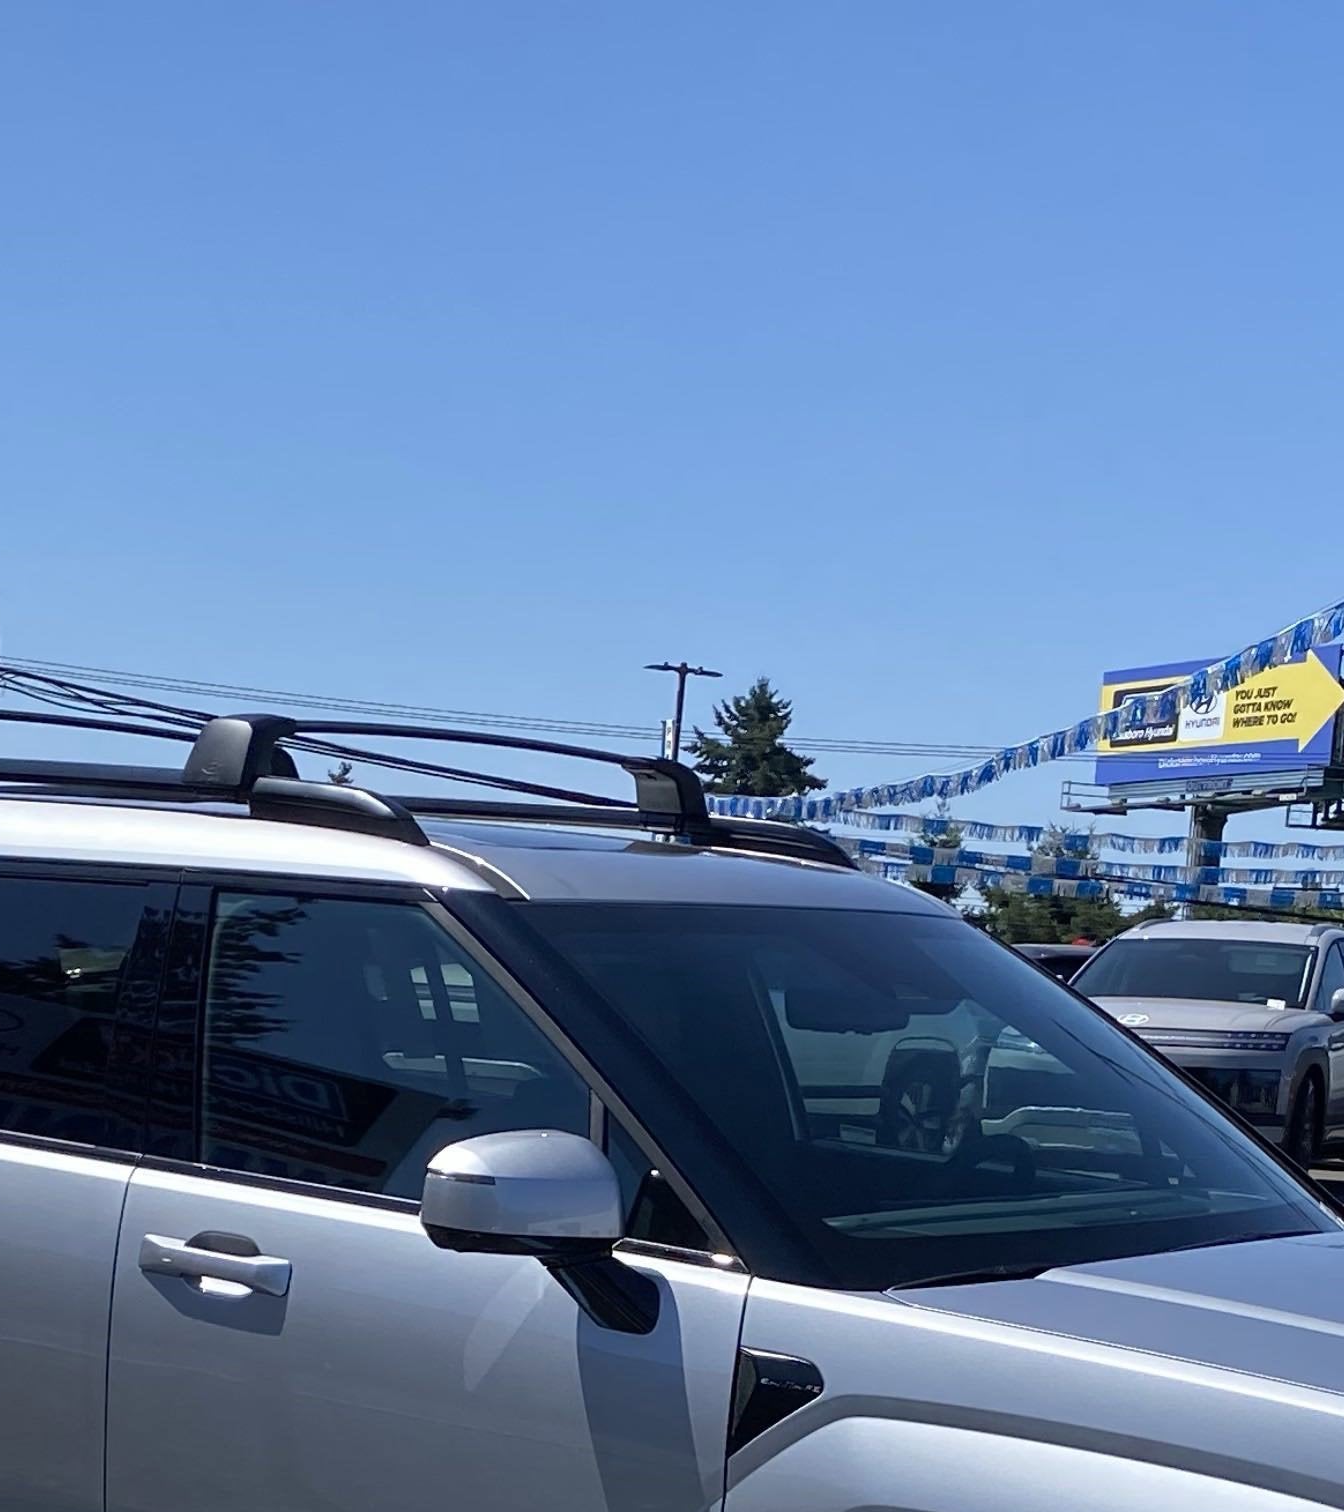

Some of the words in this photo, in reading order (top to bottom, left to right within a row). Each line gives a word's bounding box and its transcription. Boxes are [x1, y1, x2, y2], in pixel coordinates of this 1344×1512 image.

[1235, 688, 1254, 701] YOU
[1254, 686, 1278, 699] JUST
[1233, 702, 1262, 714] GOTTA
[1264, 699, 1294, 711] KNOW
[1184, 716, 1221, 730] HYUNDAI
[1232, 715, 1265, 728] WHERE
[1267, 714, 1278, 725] TO
[1280, 712, 1297, 724] GO!
